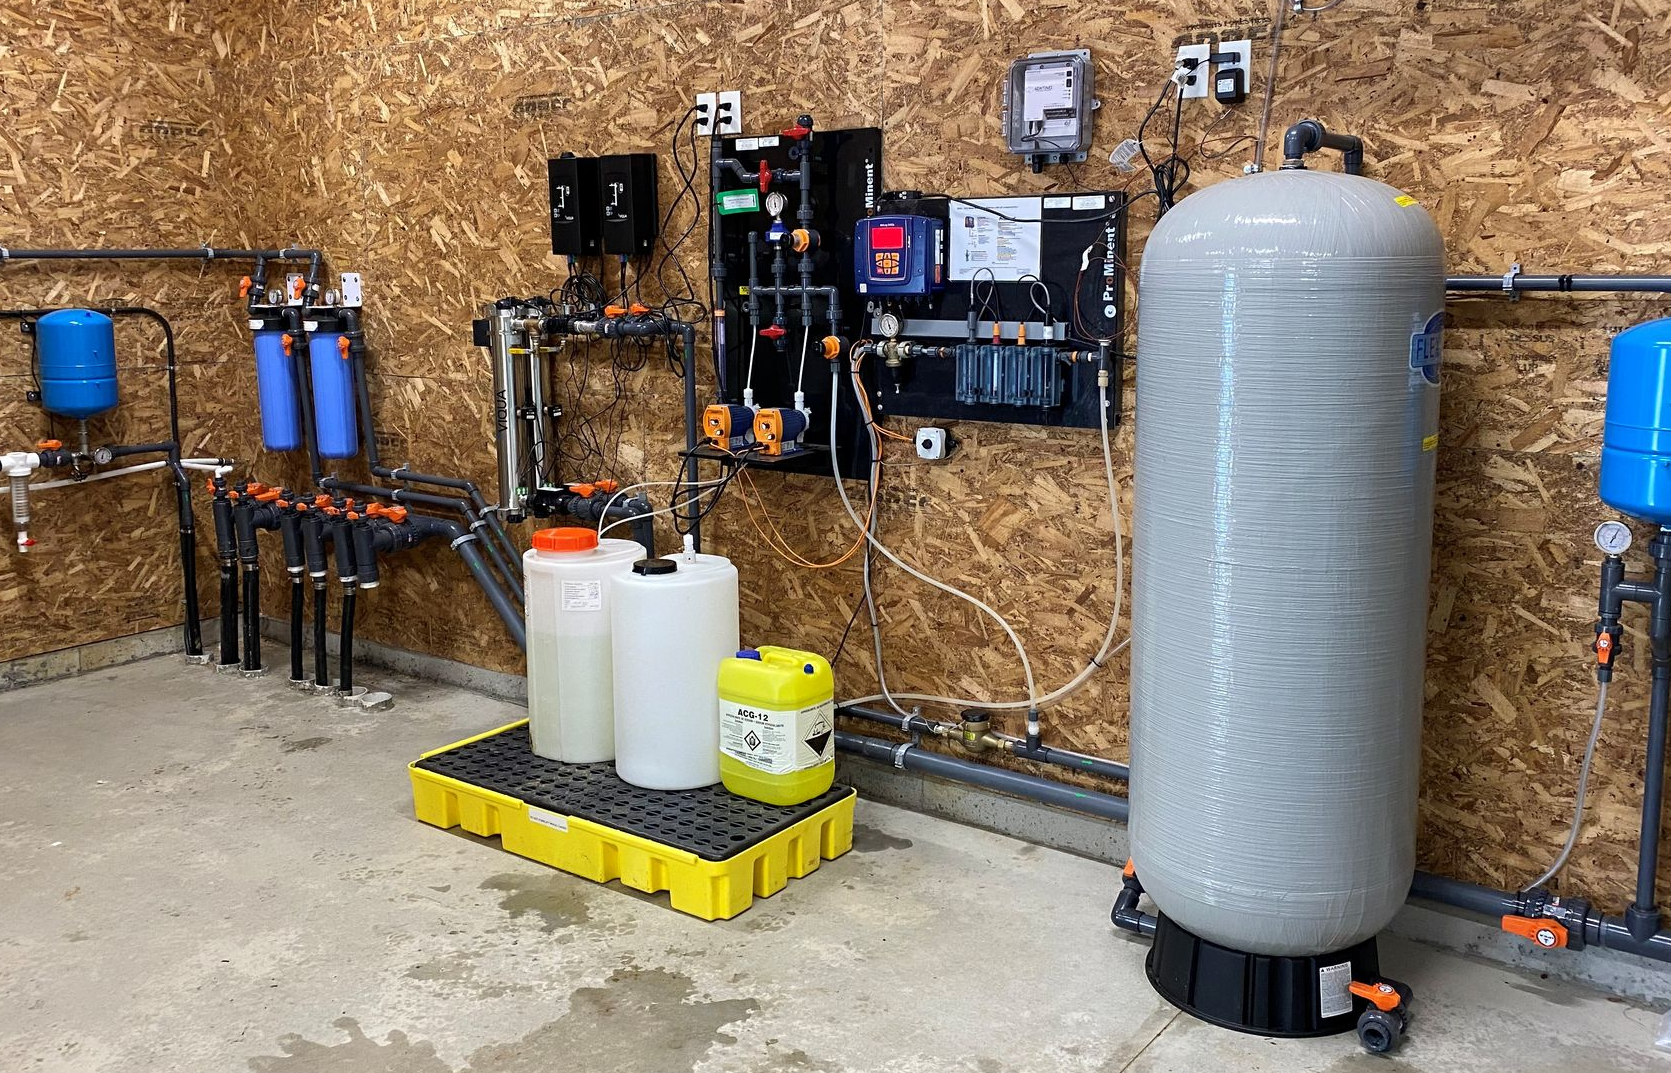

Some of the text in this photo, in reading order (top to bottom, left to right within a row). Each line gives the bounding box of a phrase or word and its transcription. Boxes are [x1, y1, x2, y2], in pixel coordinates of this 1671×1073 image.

[1102, 226, 1116, 302] ProMinent
[496, 389, 508, 433] VIQUA
[737, 708, 769, 722] ACG-12
